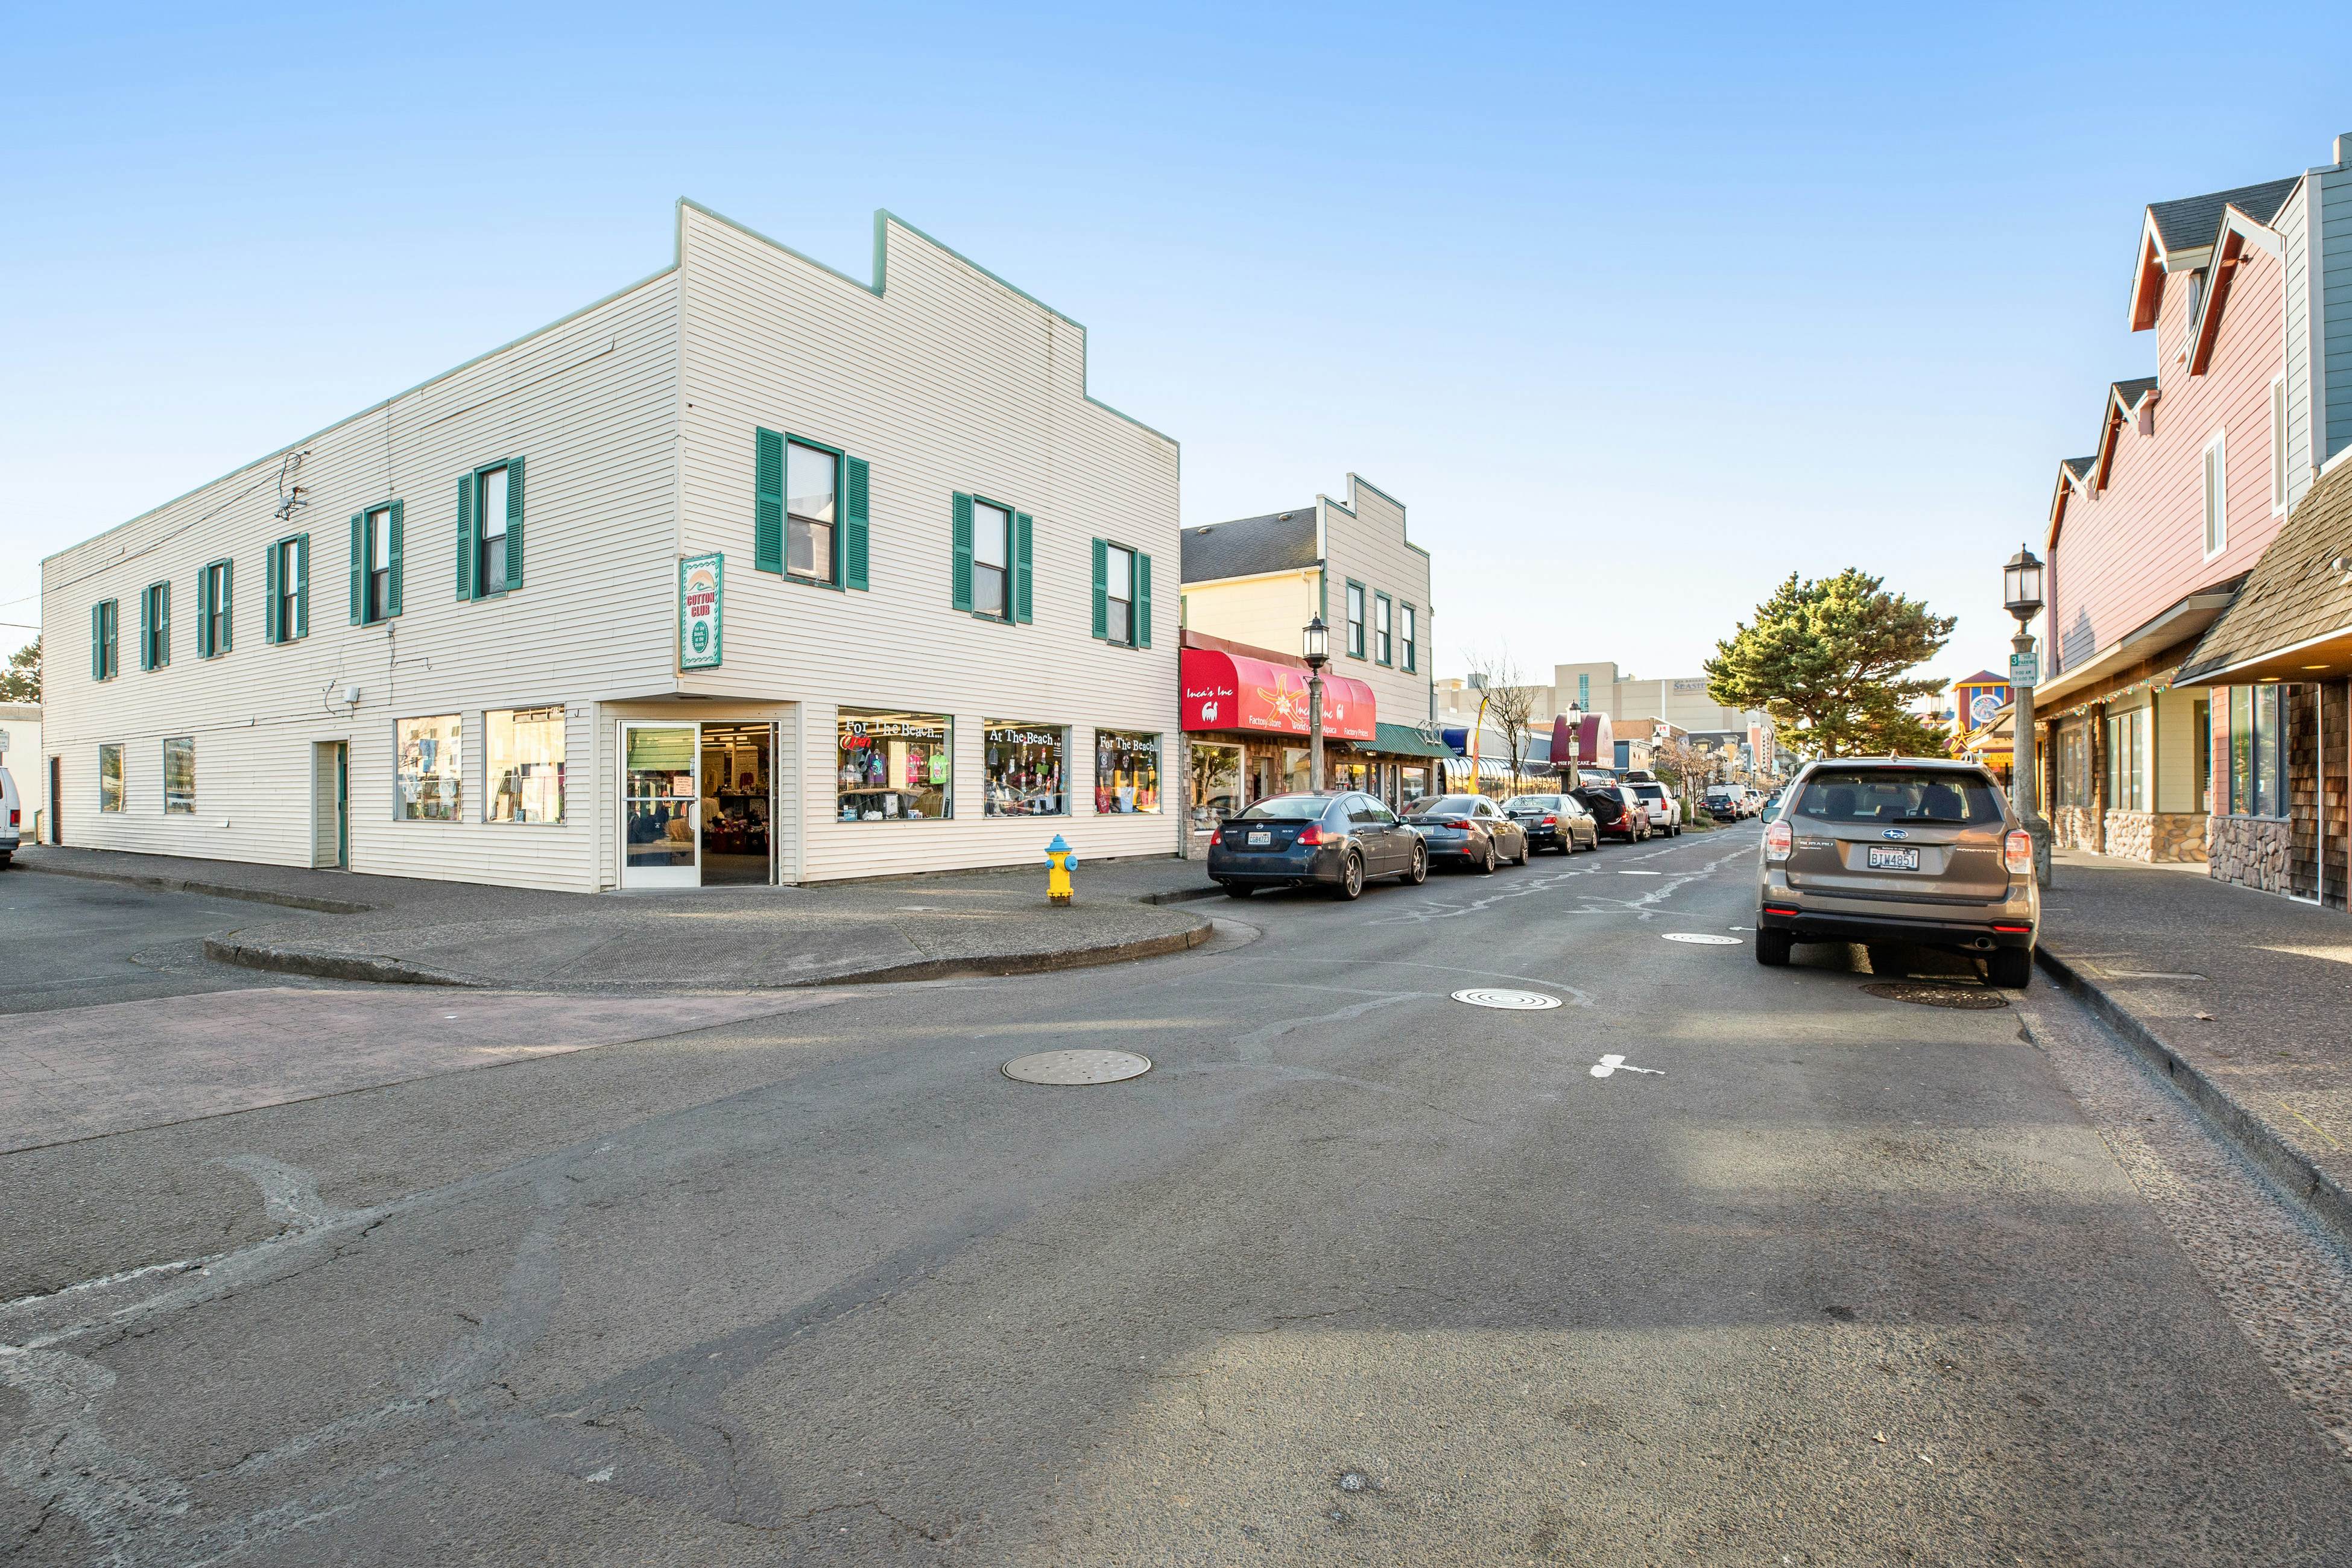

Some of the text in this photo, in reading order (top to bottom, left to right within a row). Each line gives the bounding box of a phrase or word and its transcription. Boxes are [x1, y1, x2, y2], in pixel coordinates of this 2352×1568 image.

[687, 592, 715, 606] COTTON
[691, 605, 710, 617] CLUB
[2011, 656, 2017, 665] 3
[1187, 686, 1233, 698] Inca's Inc
[845, 718, 868, 734] For
[874, 718, 899, 735] The
[1250, 715, 1267, 728] Factory
[990, 729, 1002, 742] At
[1005, 729, 1023, 743] The
[1323, 725, 1337, 735] Alpaca
[1344, 727, 1358, 738] Factory
[841, 735, 871, 749] Open
[1100, 736, 1113, 749] For
[1116, 737, 1131, 750] The
[1872, 853, 1914, 866] BIW4851
